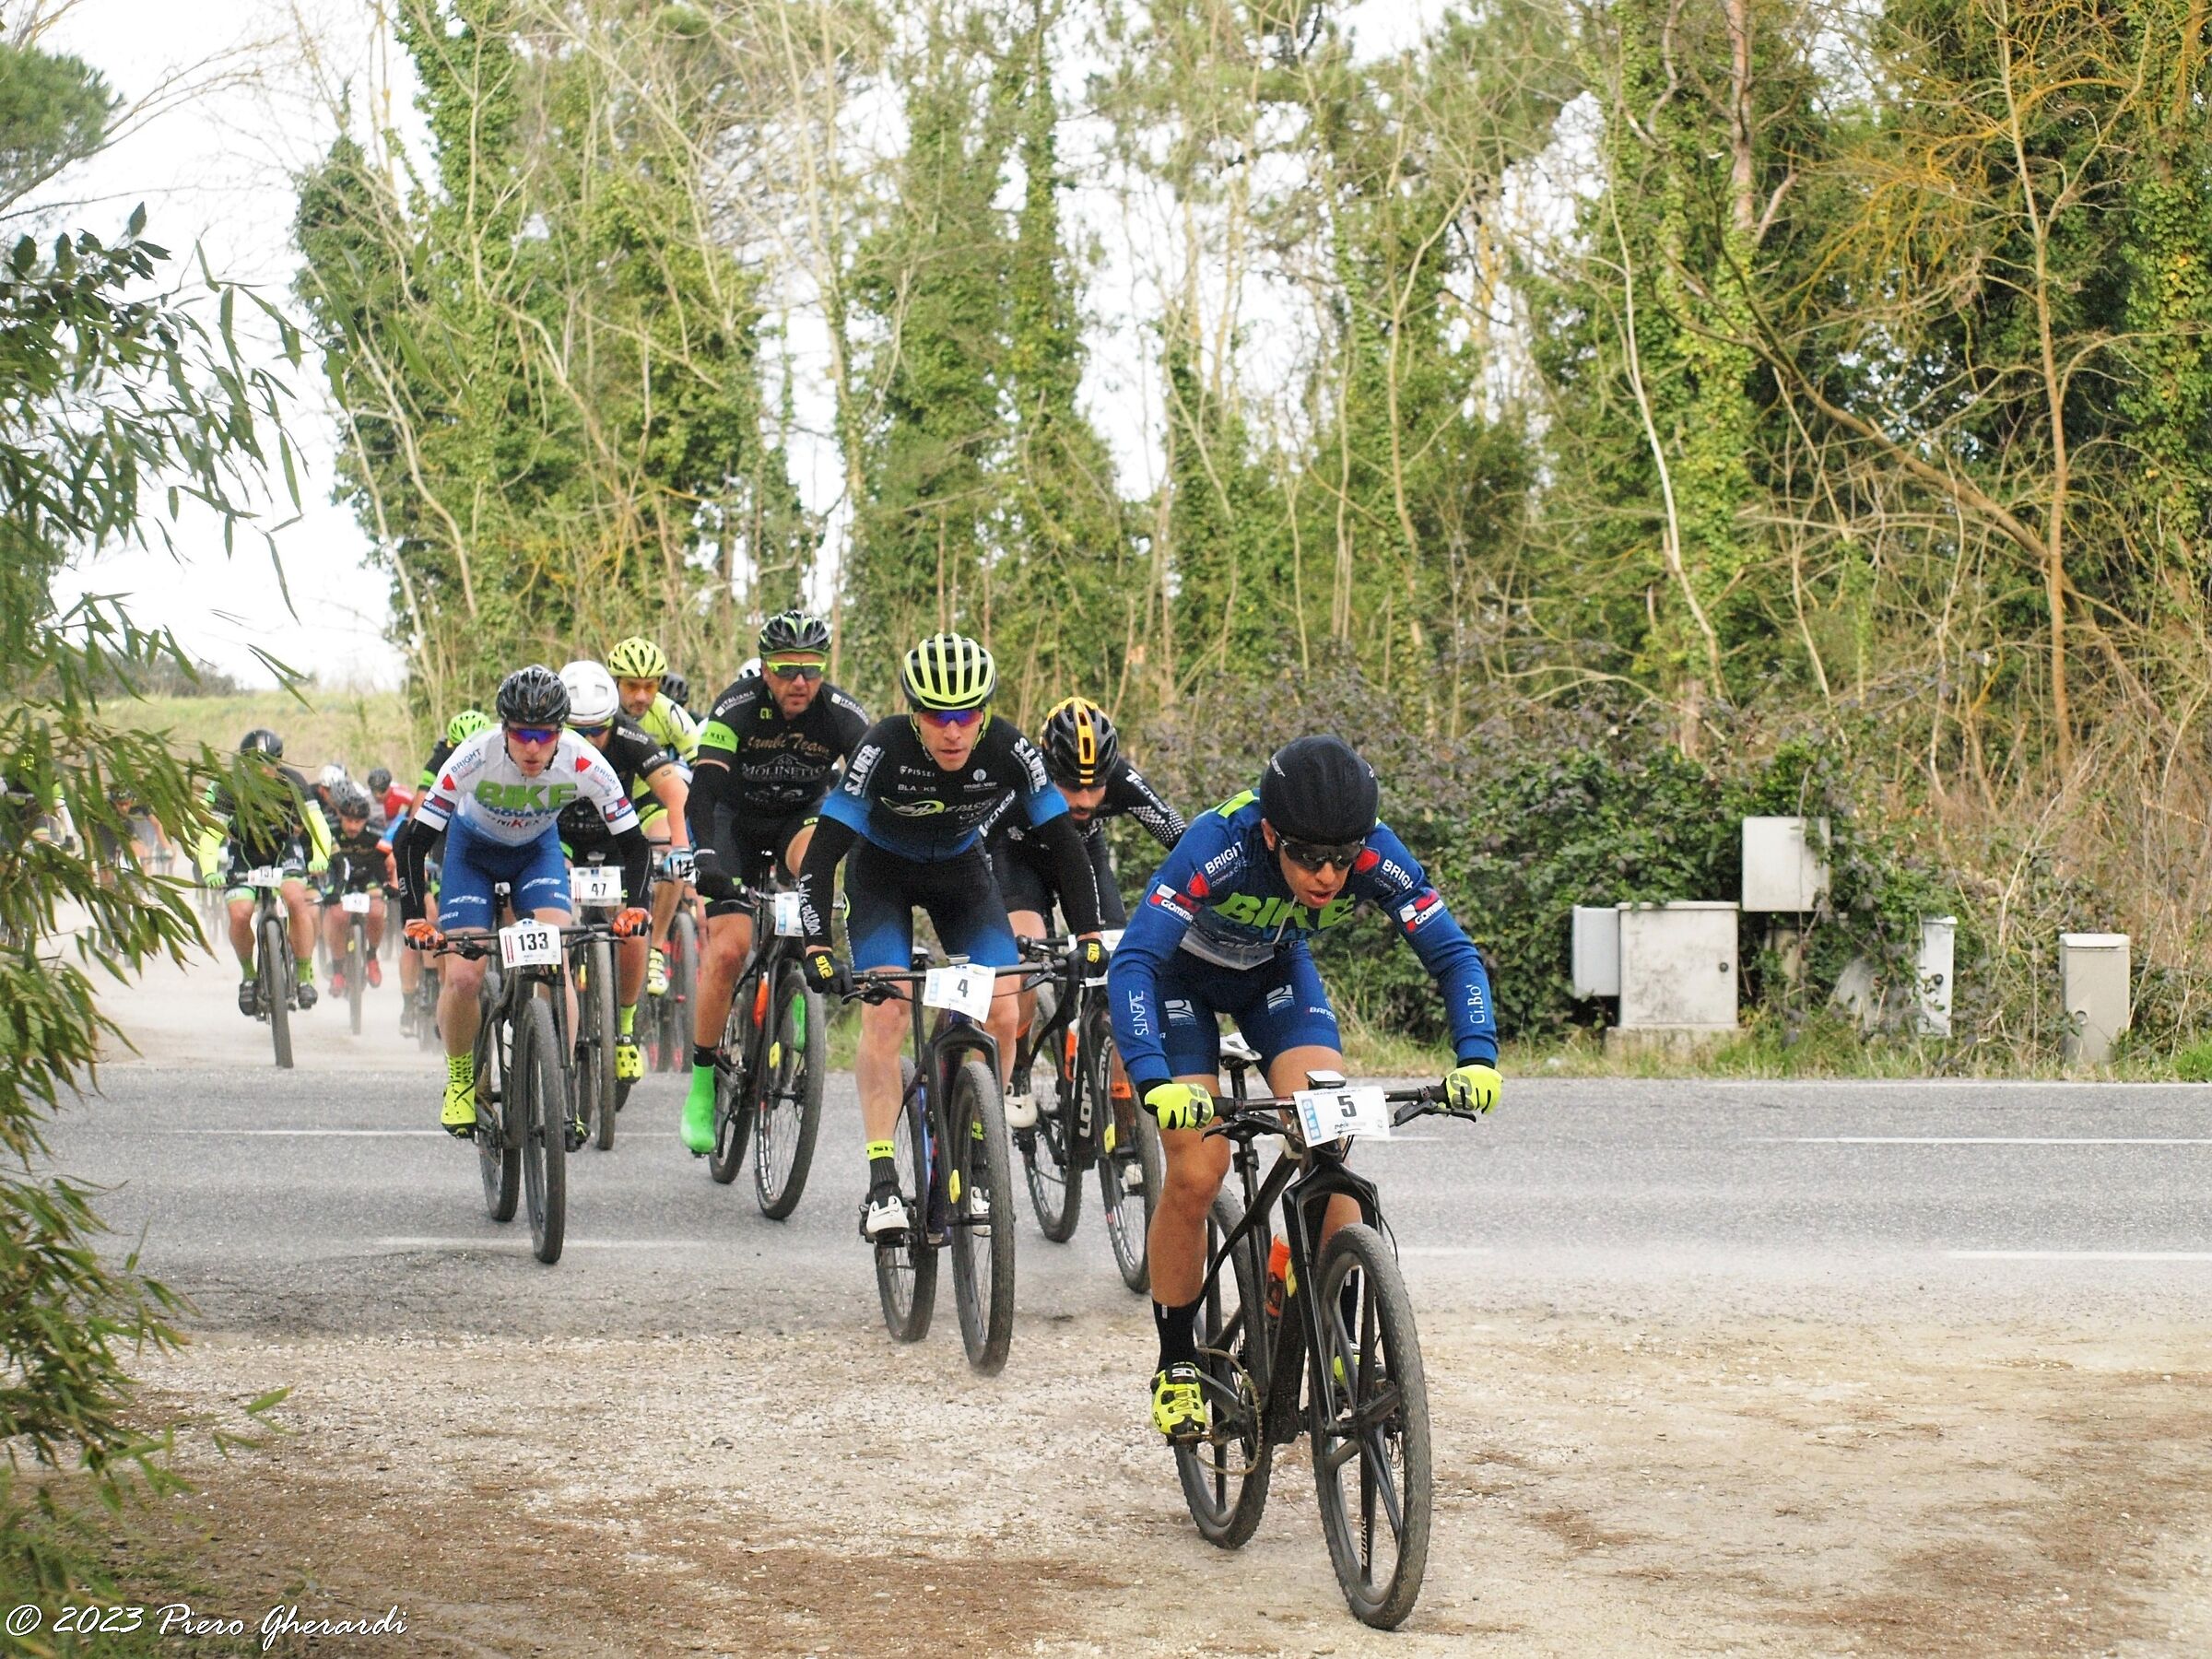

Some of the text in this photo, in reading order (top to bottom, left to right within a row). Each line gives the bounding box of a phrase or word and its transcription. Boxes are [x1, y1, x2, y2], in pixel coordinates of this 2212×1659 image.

[450, 747, 481, 773] BRIGHT
[474, 780, 578, 811] BIKE
[1382, 858, 1414, 890] BRIGH
[591, 882, 607, 897] 47
[1211, 892, 1357, 930] BIKE
[518, 932, 549, 951] 133
[957, 978, 969, 998] 4
[1336, 1094, 1358, 1118] 5
